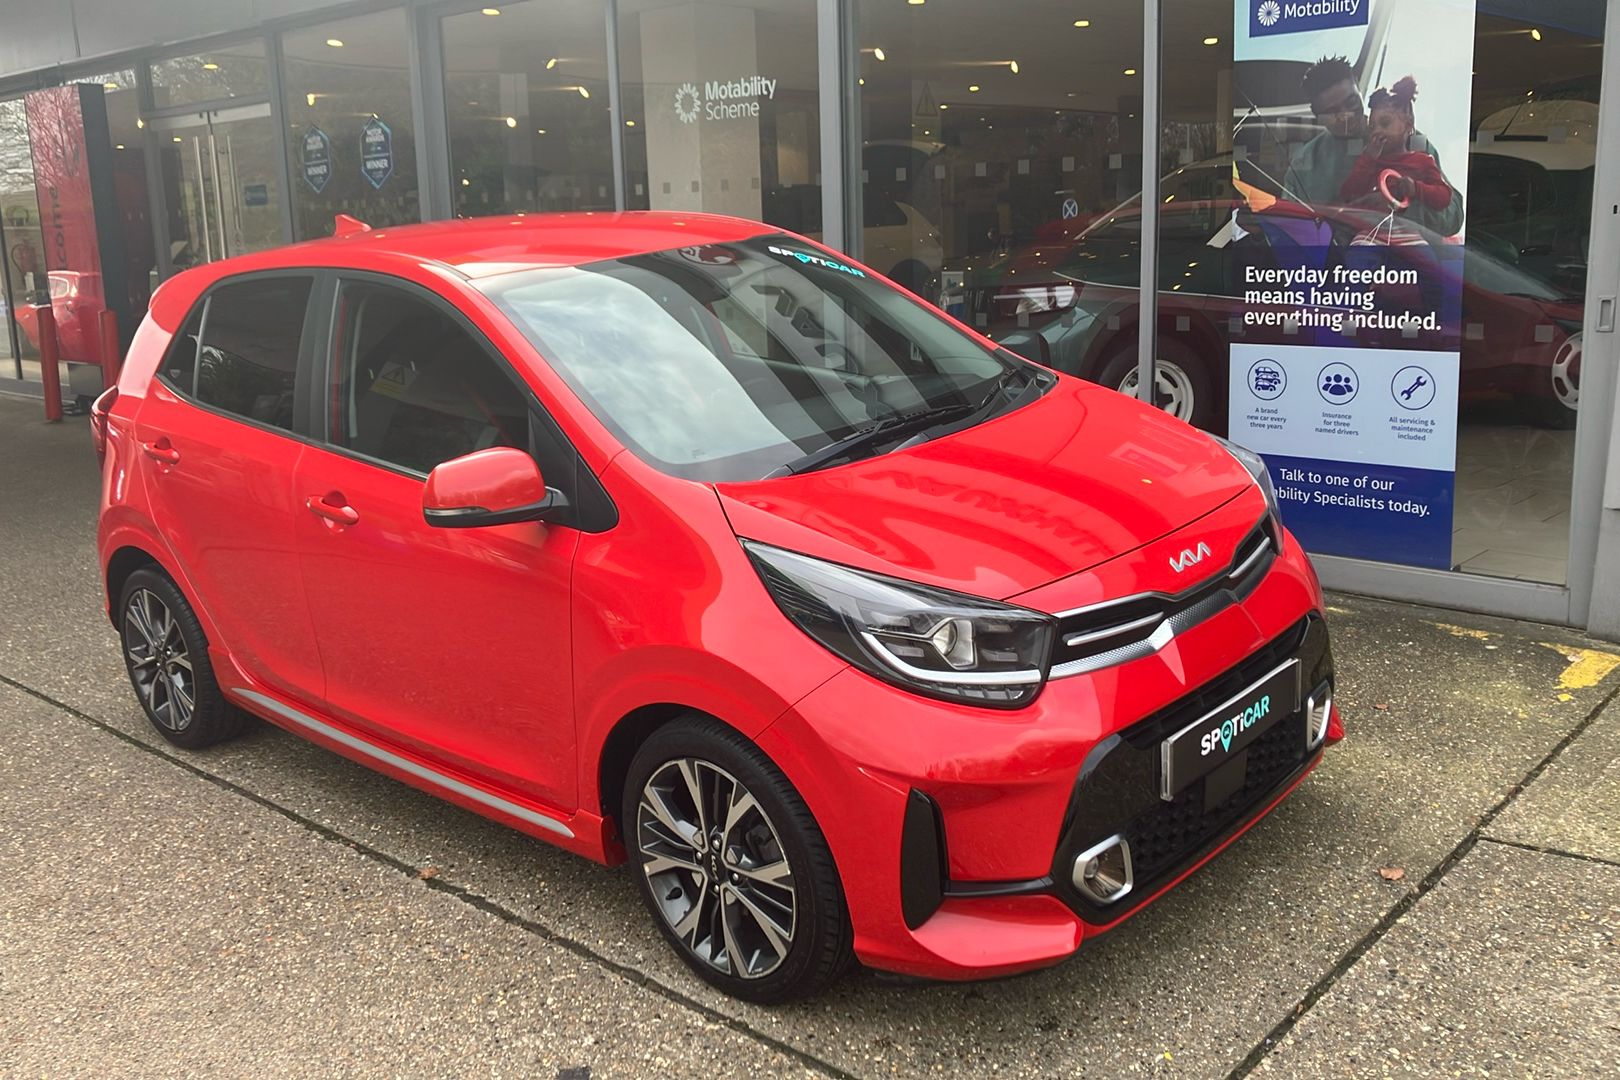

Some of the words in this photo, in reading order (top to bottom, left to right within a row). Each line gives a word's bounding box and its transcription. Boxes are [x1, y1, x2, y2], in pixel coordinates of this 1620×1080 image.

[1284, 0, 1360, 19] Motability
[705, 76, 777, 100] Motability
[705, 101, 760, 120] Scheme
[1245, 265, 1329, 288] Everyday
[1333, 265, 1418, 285] freedom
[1245, 288, 1305, 305] means
[1310, 287, 1375, 311] having
[1260, 407, 1278, 415] brand
[1322, 411, 1352, 420] Insurance
[1270, 416, 1287, 424] every
[1334, 420, 1351, 428] three
[1399, 417, 1428, 427] servicing
[1250, 421, 1266, 429] three
[1267, 423, 1283, 431] years
[1391, 425, 1433, 434] maintenance
[1337, 427, 1359, 436] drivers
[1397, 433, 1426, 441] included
[1280, 468, 1305, 482] Talk
[1308, 472, 1322, 484] to
[1325, 475, 1350, 487] one
[1353, 476, 1369, 488] of
[1371, 479, 1395, 491] our
[1274, 486, 1311, 504] bility
[1313, 491, 1385, 510] Specialists
[1388, 500, 1431, 518] today.
[1169, 541, 1212, 573] KIA
